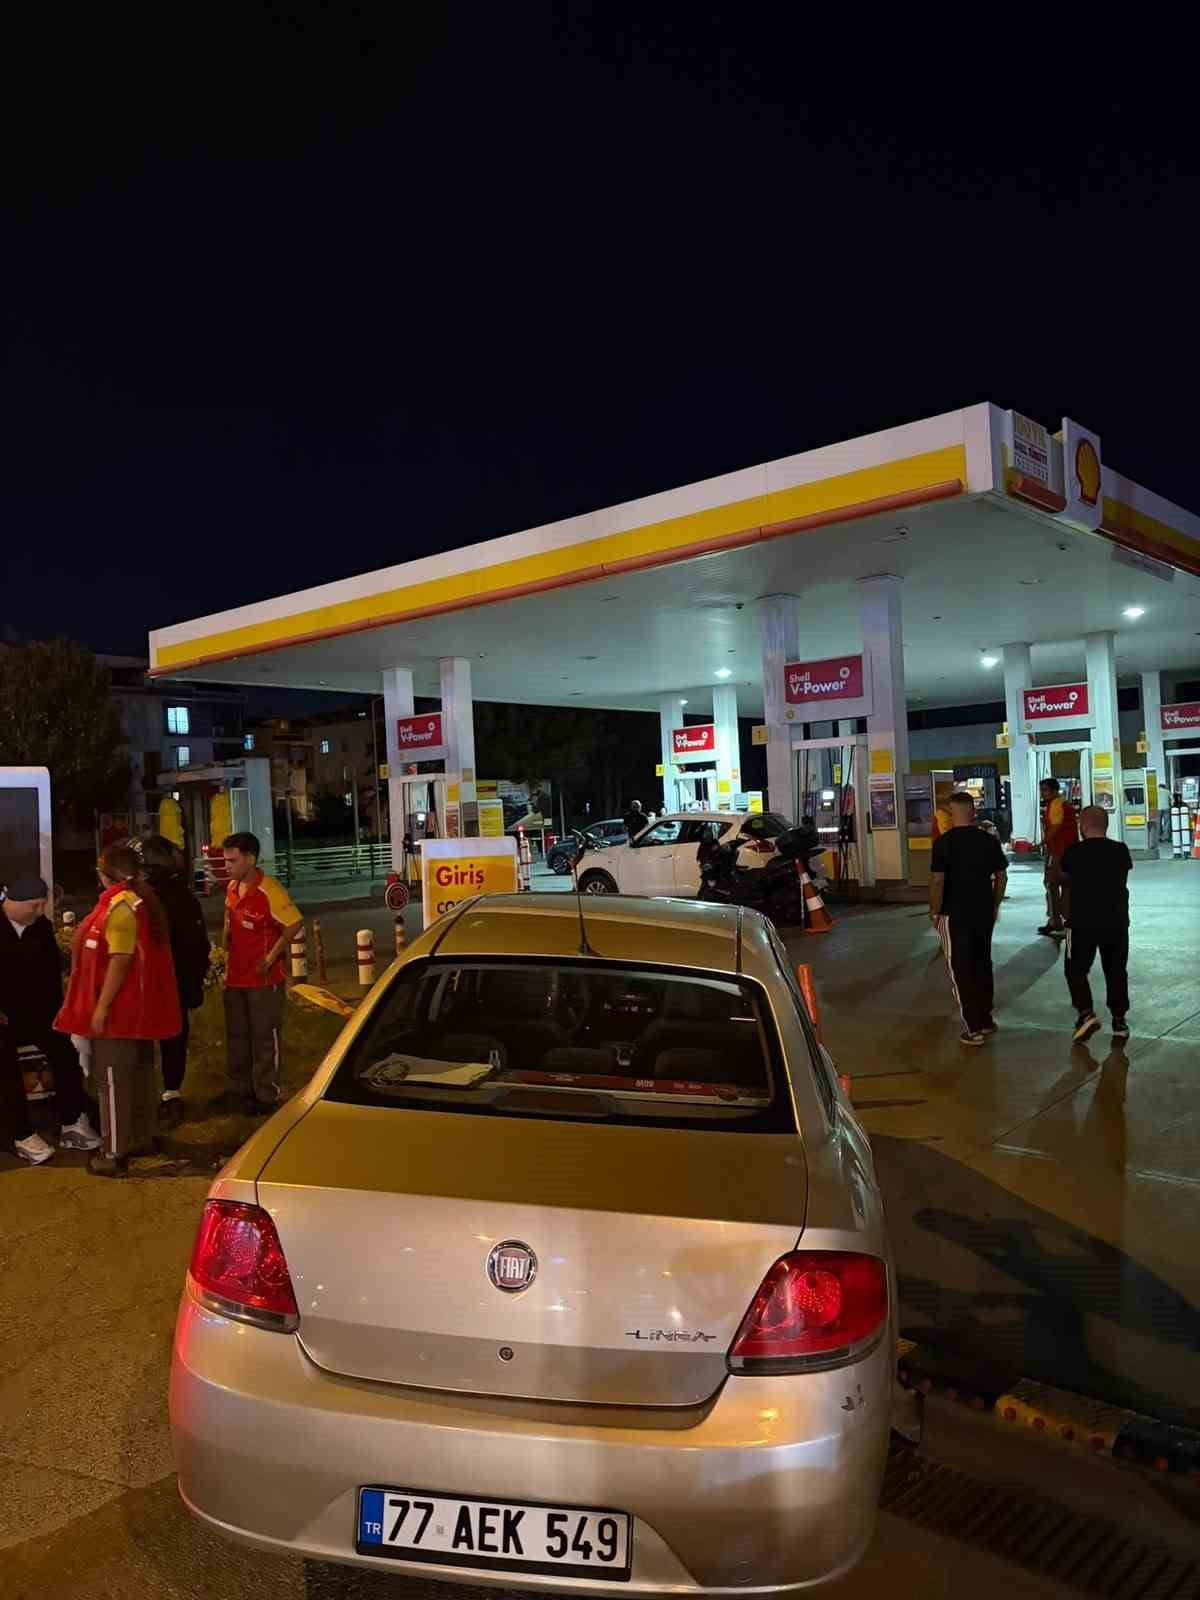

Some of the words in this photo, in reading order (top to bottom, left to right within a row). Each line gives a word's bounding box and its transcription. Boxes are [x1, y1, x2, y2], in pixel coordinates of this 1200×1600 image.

[789, 672, 810, 683] Shell
[790, 680, 846, 695] V-Power
[1027, 695, 1046, 703] Shell
[1028, 702, 1074, 712] V-Power
[436, 863, 485, 890] Giriş
[501, 1255, 528, 1280] FIAT
[365, 1520, 381, 1535] TR
[389, 1499, 434, 1544] 77
[451, 1505, 526, 1555] AEK
[546, 1512, 618, 1562] 549
